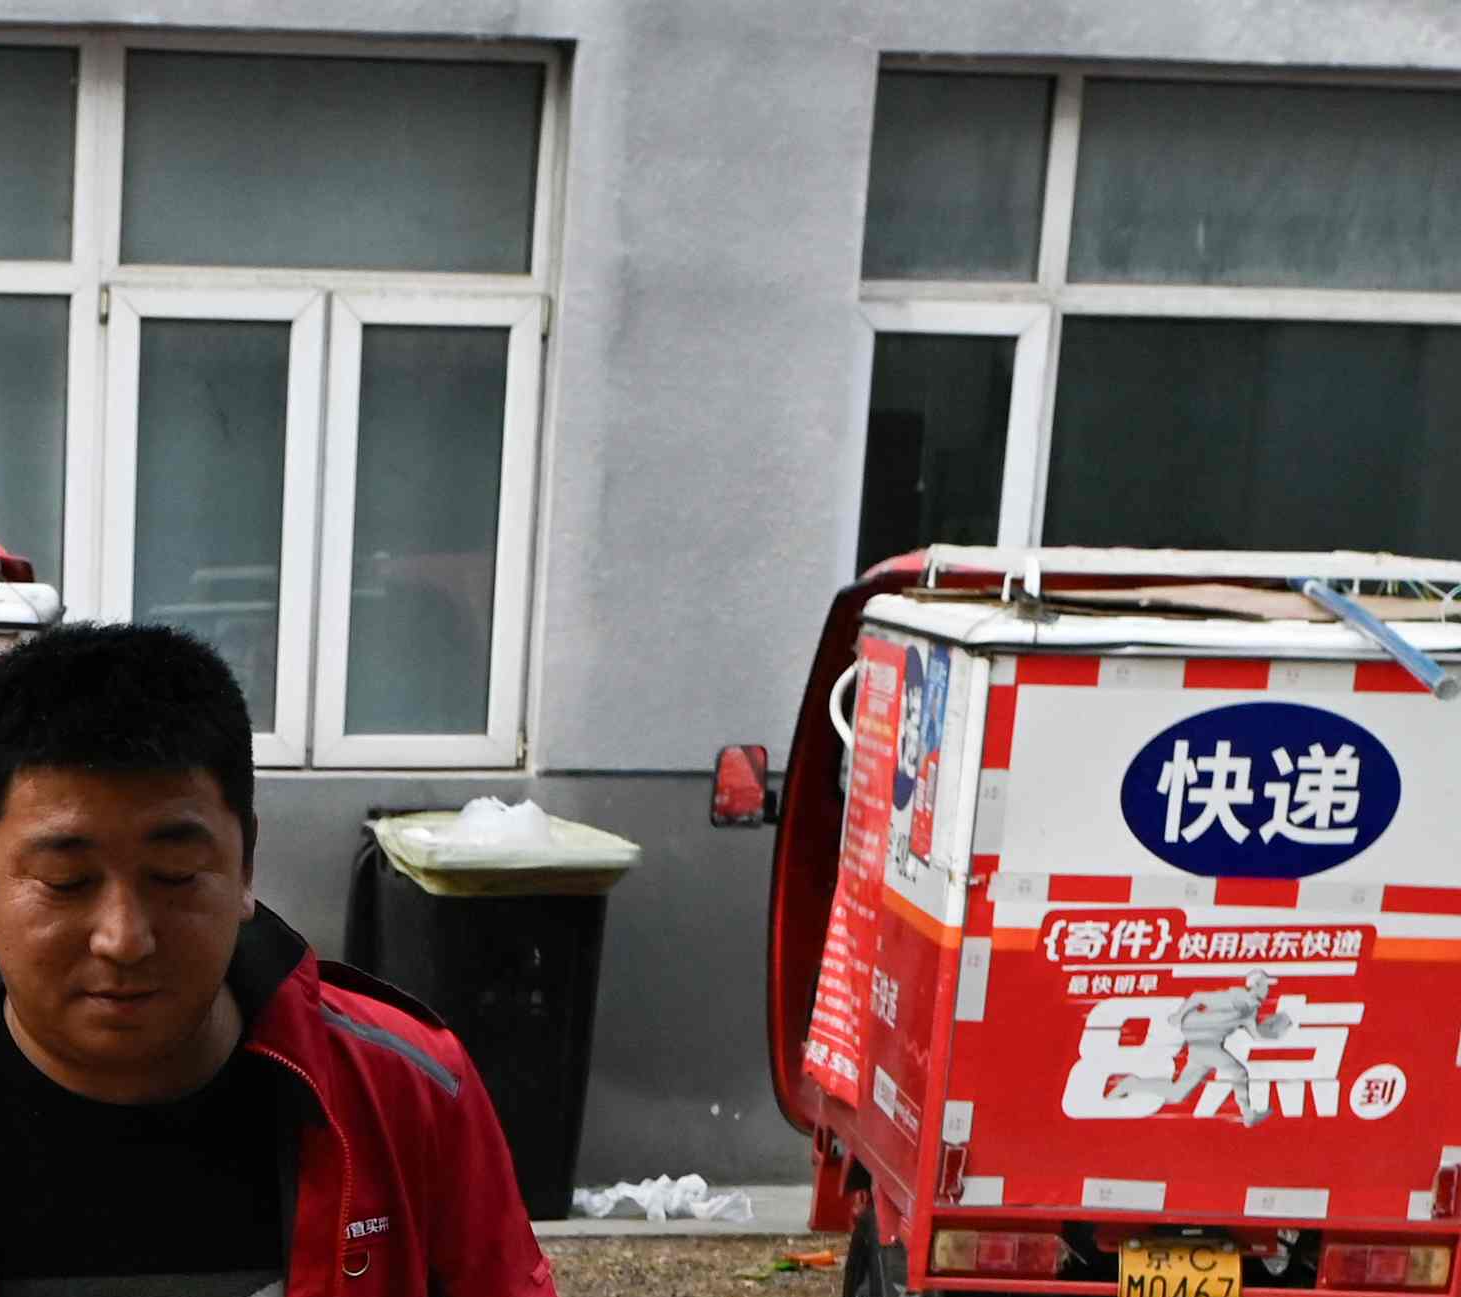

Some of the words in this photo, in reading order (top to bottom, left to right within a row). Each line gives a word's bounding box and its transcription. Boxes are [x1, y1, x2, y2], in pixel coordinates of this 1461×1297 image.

[1157, 738, 1361, 846] 快递
[1177, 929, 1364, 959] 快用京东快递
[1067, 975, 1159, 995] 最快明早
[1362, 1079, 1397, 1106] 到
